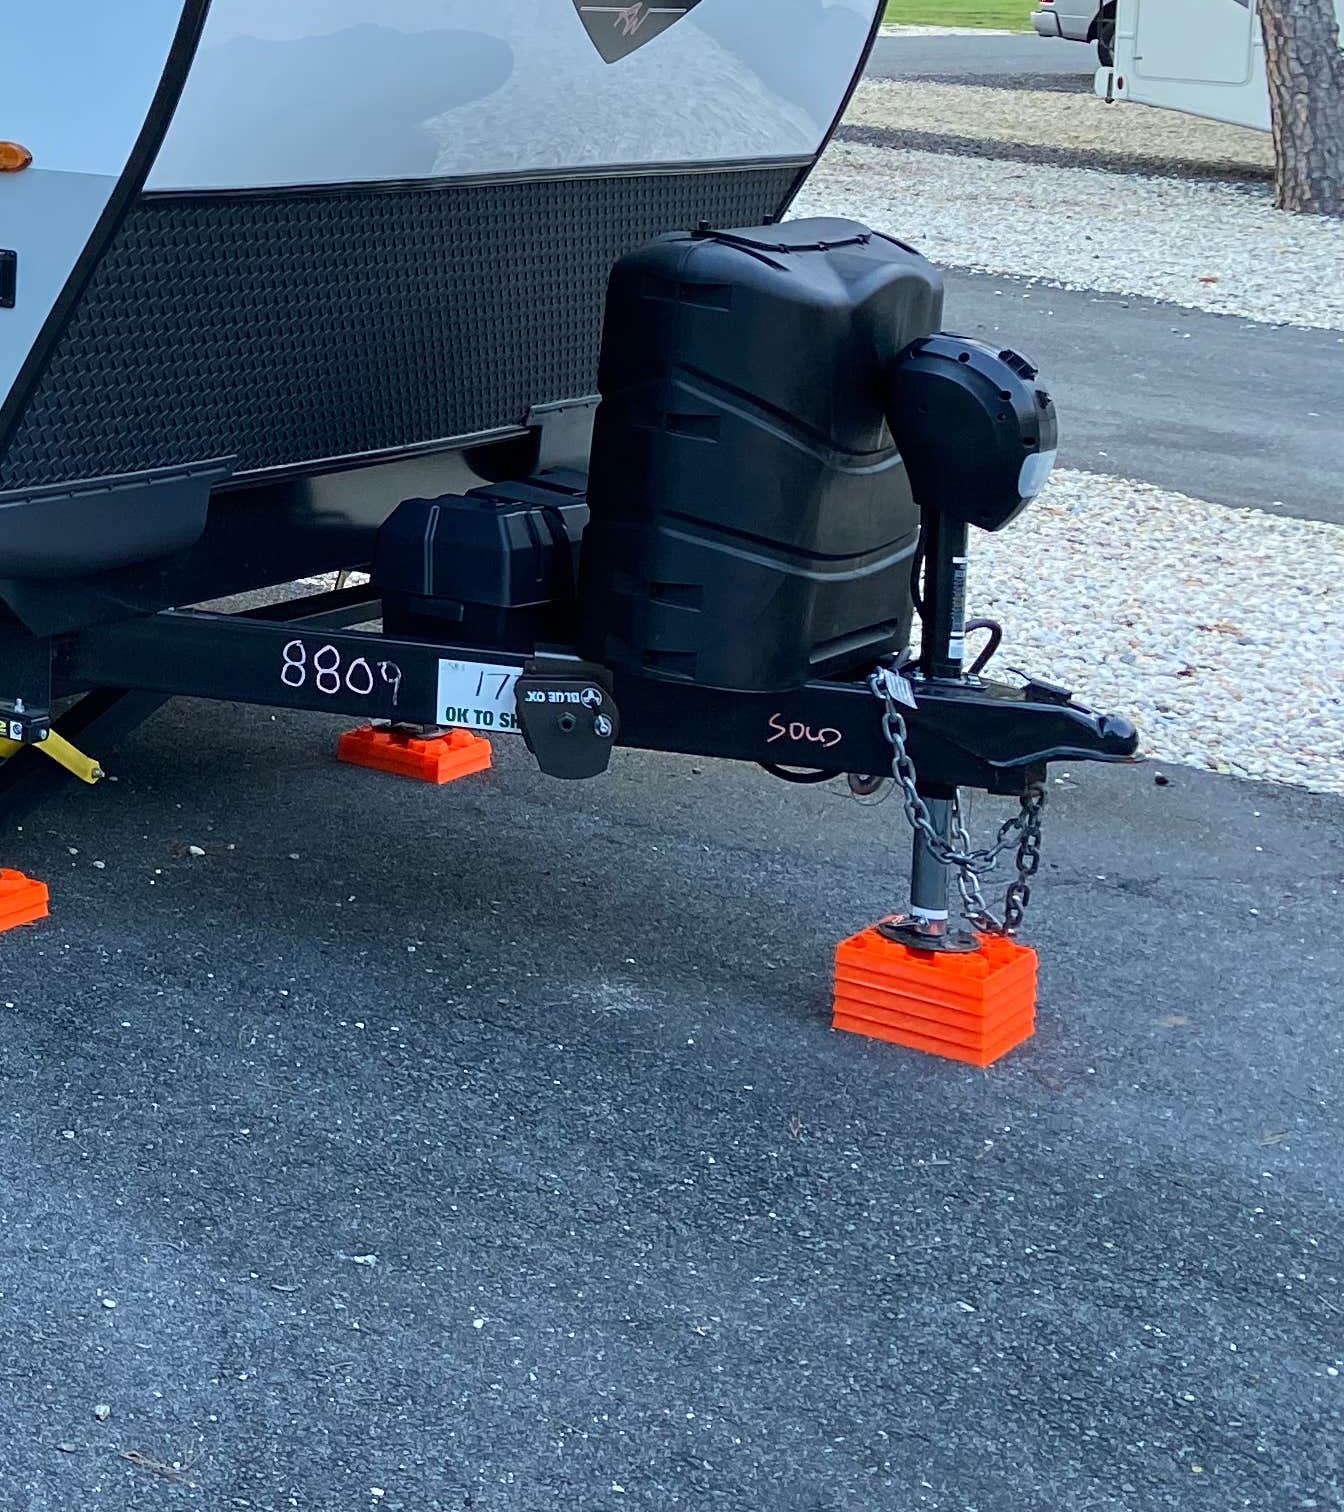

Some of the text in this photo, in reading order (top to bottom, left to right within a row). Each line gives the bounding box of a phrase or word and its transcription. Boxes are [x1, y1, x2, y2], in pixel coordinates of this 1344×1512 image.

[280, 639, 402, 706] 8809
[475, 670, 521, 700] 17
[526, 690, 580, 703] BLUE OX
[445, 706, 518, 729] OK TO SH
[767, 712, 842, 748] SOLD
